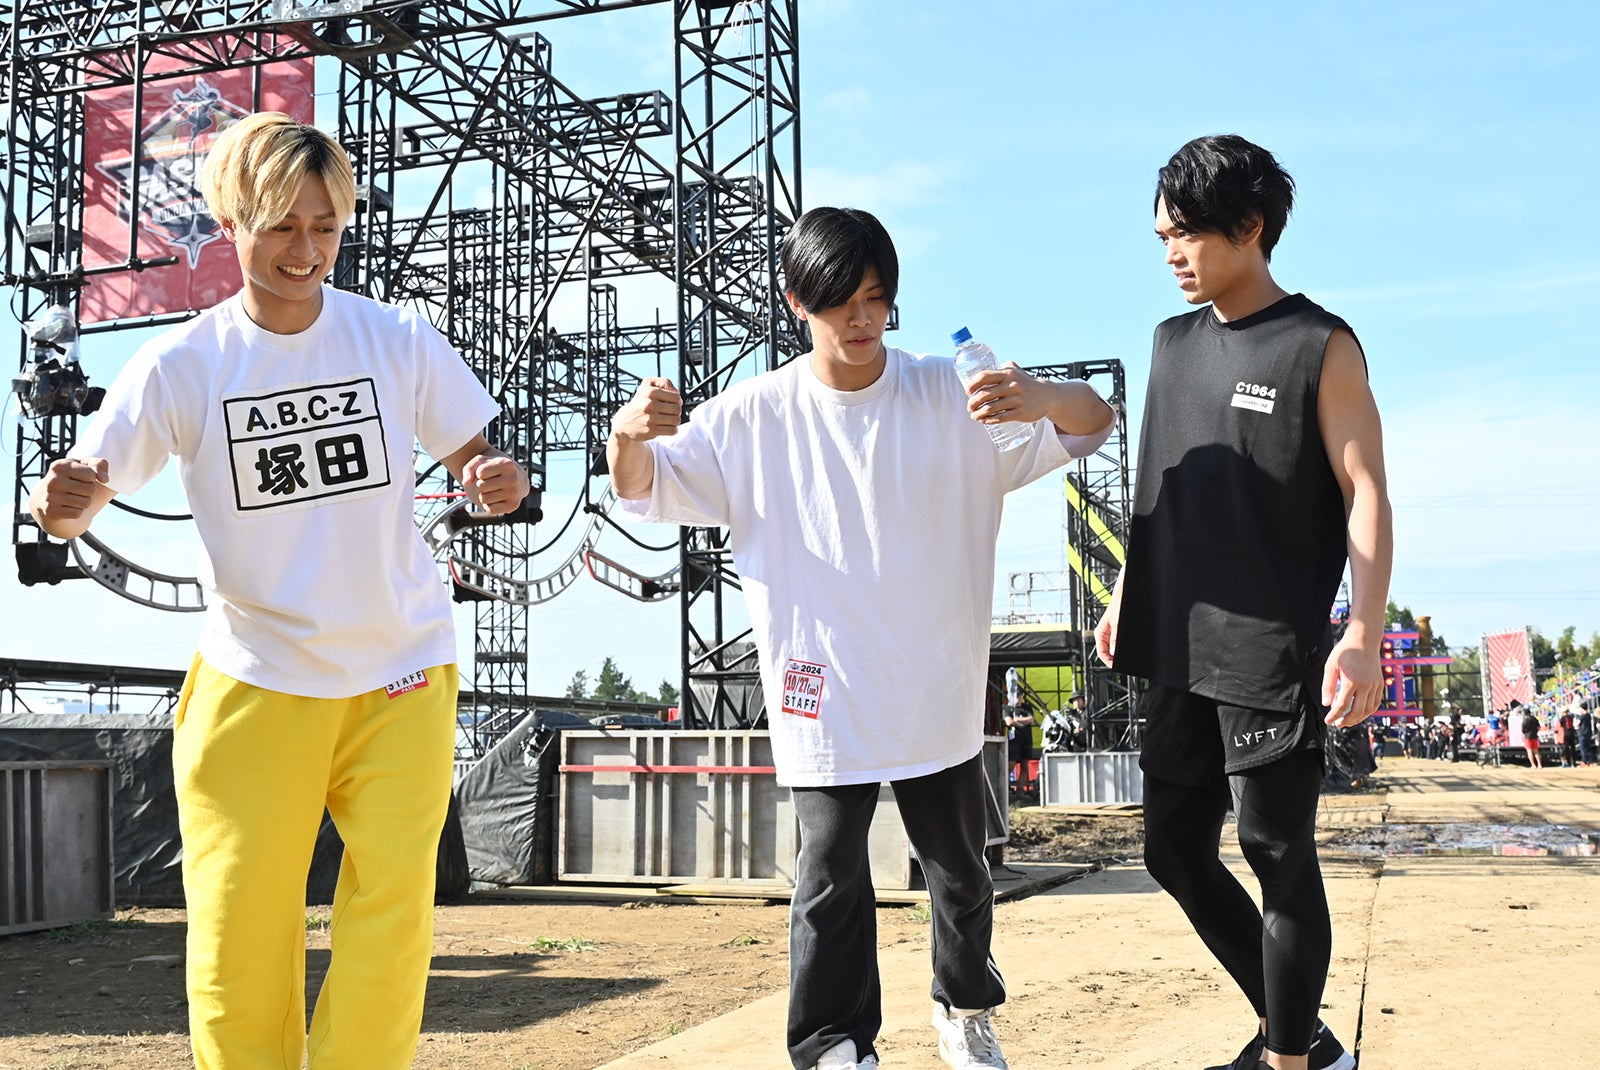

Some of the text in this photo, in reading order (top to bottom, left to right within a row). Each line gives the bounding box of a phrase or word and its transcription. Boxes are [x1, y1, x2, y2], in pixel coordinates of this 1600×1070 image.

[160, 202, 187, 221] NINJA
[1235, 381, 1277, 399] C1964
[246, 390, 362, 432] A.B.C-Z
[255, 433, 368, 496] 塚田
[800, 664, 822, 675] 2024
[784, 694, 817, 711] STAFF
